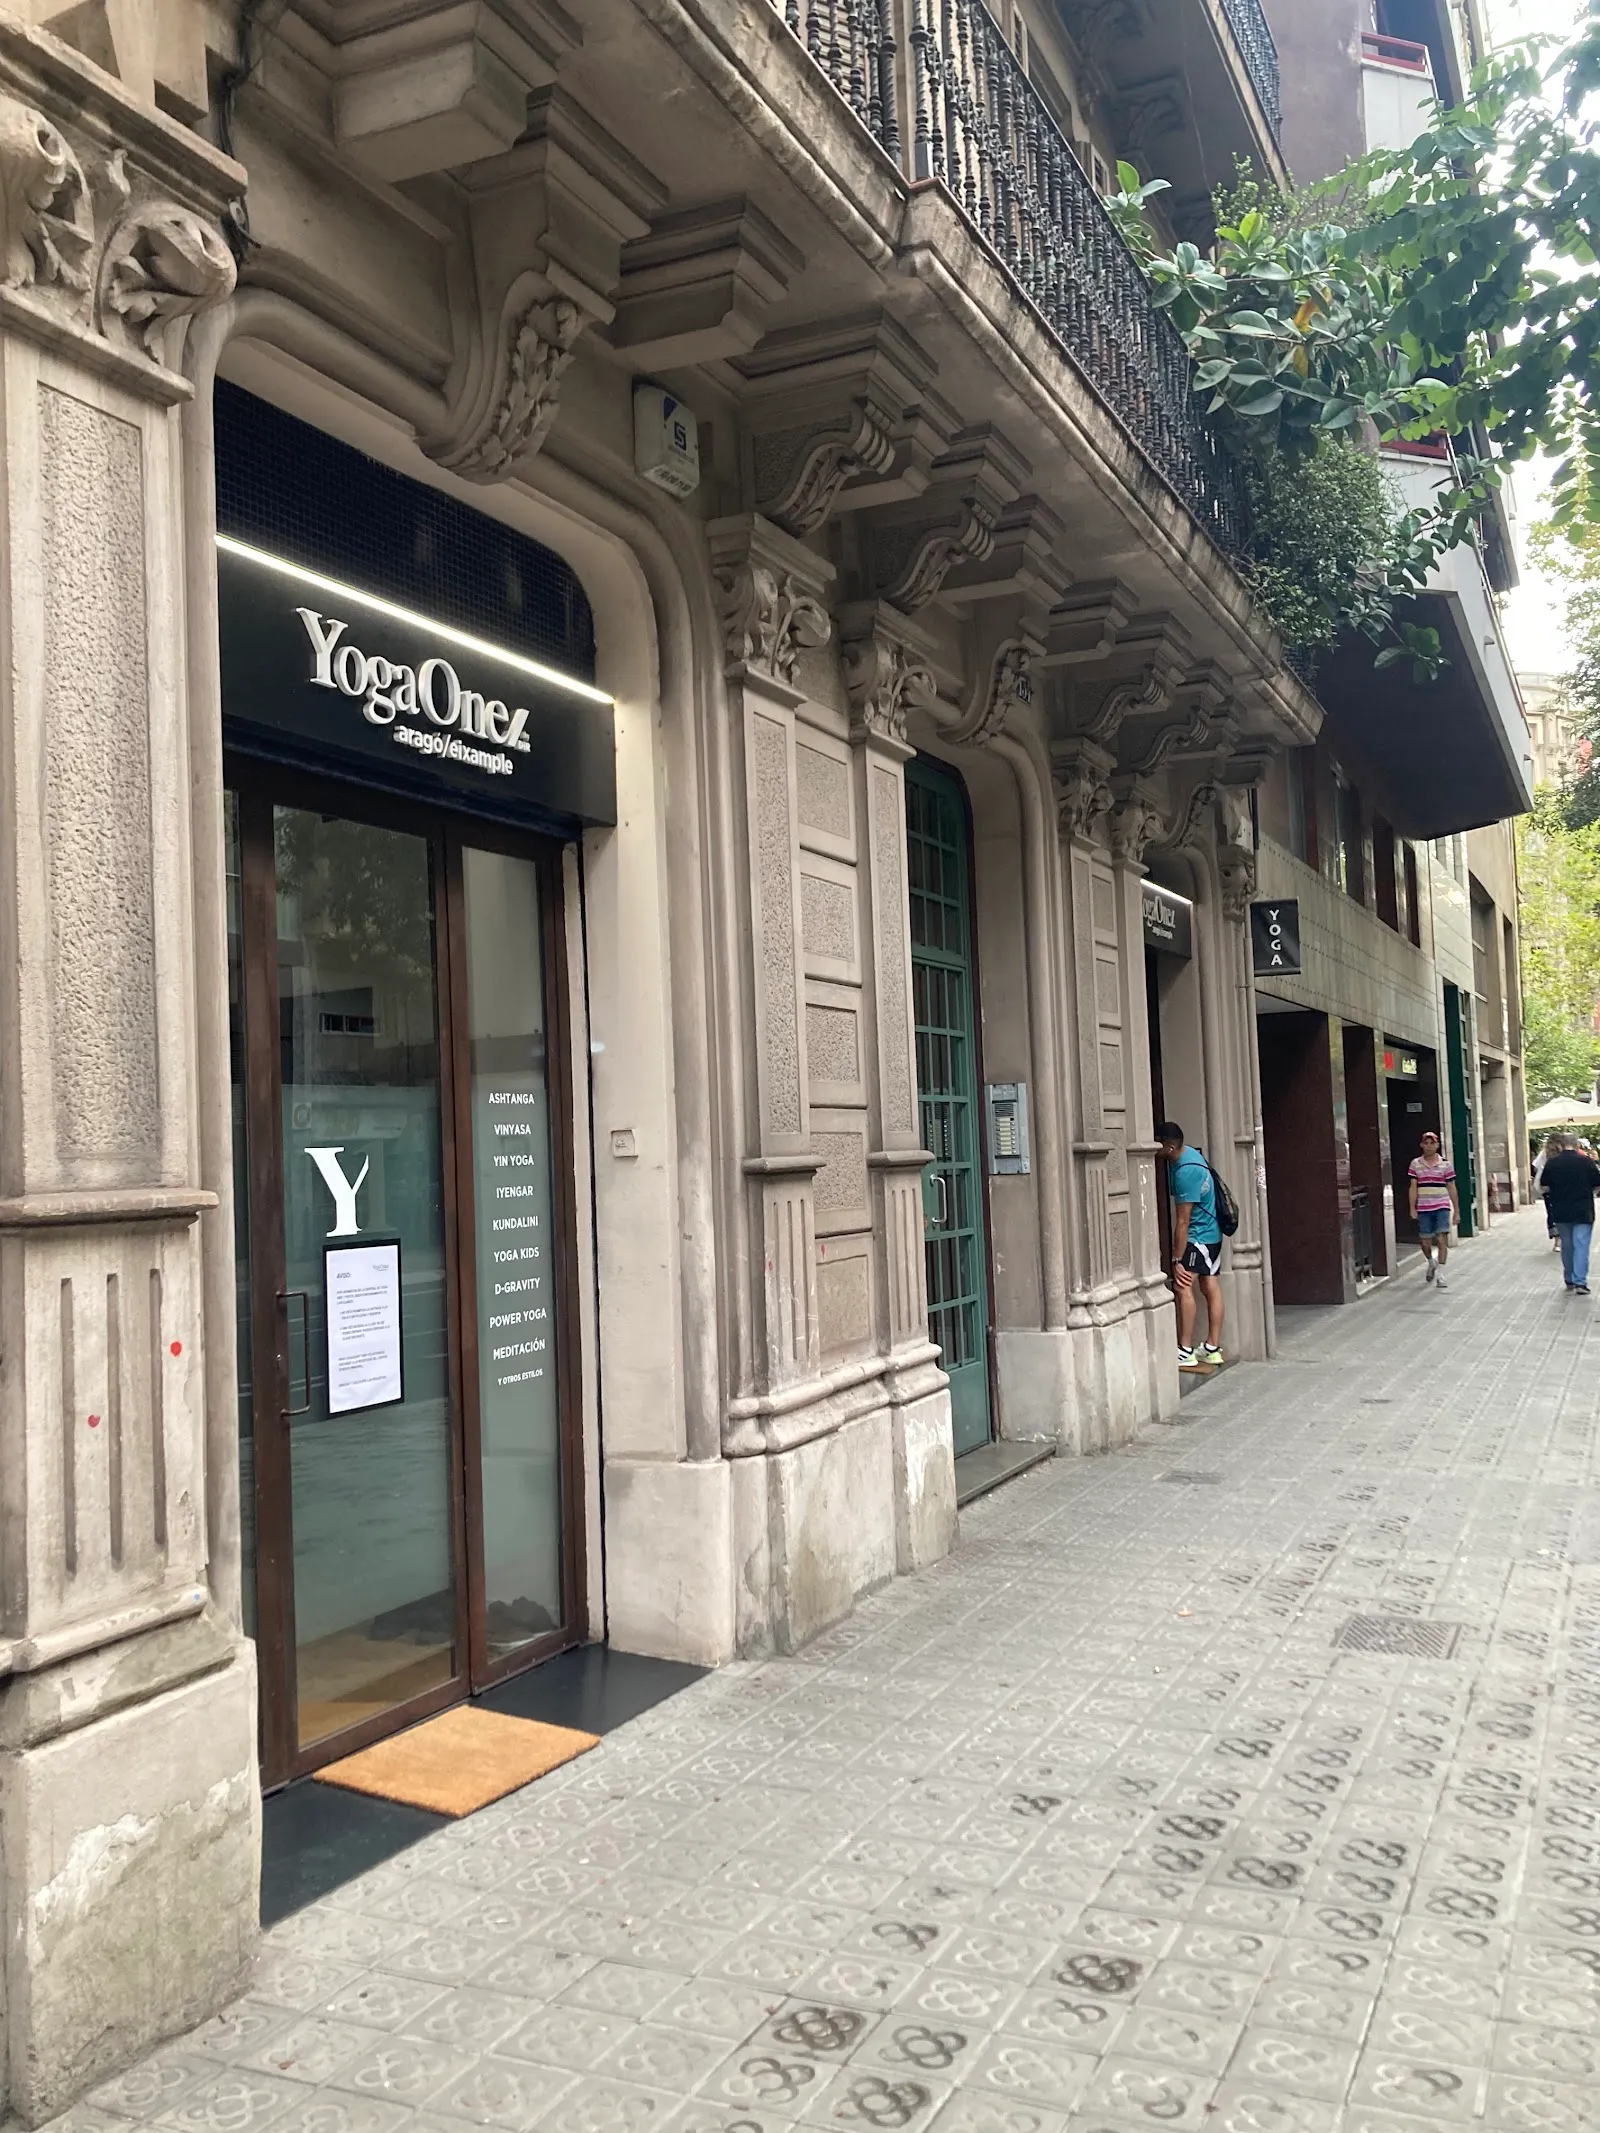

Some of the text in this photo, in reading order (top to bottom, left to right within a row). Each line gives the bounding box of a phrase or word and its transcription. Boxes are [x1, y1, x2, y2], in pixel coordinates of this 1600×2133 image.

[296, 608, 530, 747] YogaOne
[394, 724, 513, 775] aragó/eixample
[1269, 909, 1283, 966] YOGA
[488, 1093, 535, 1104] ASHTANGA
[494, 1124, 532, 1135] VINYASA
[493, 1155, 535, 1167] YIN YOGA
[496, 1185, 533, 1199] IYENGAR
[492, 1216, 539, 1231] KUNDALINI
[494, 1246, 540, 1263] YOGA KIDS
[494, 1277, 541, 1295] D-GRAVITY
[489, 1307, 547, 1329] POWER YOGA
[493, 1337, 546, 1361] MEDITACIÓN
[502, 1373, 521, 1385] OTROS
[521, 1368, 544, 1380] ESTILOS
